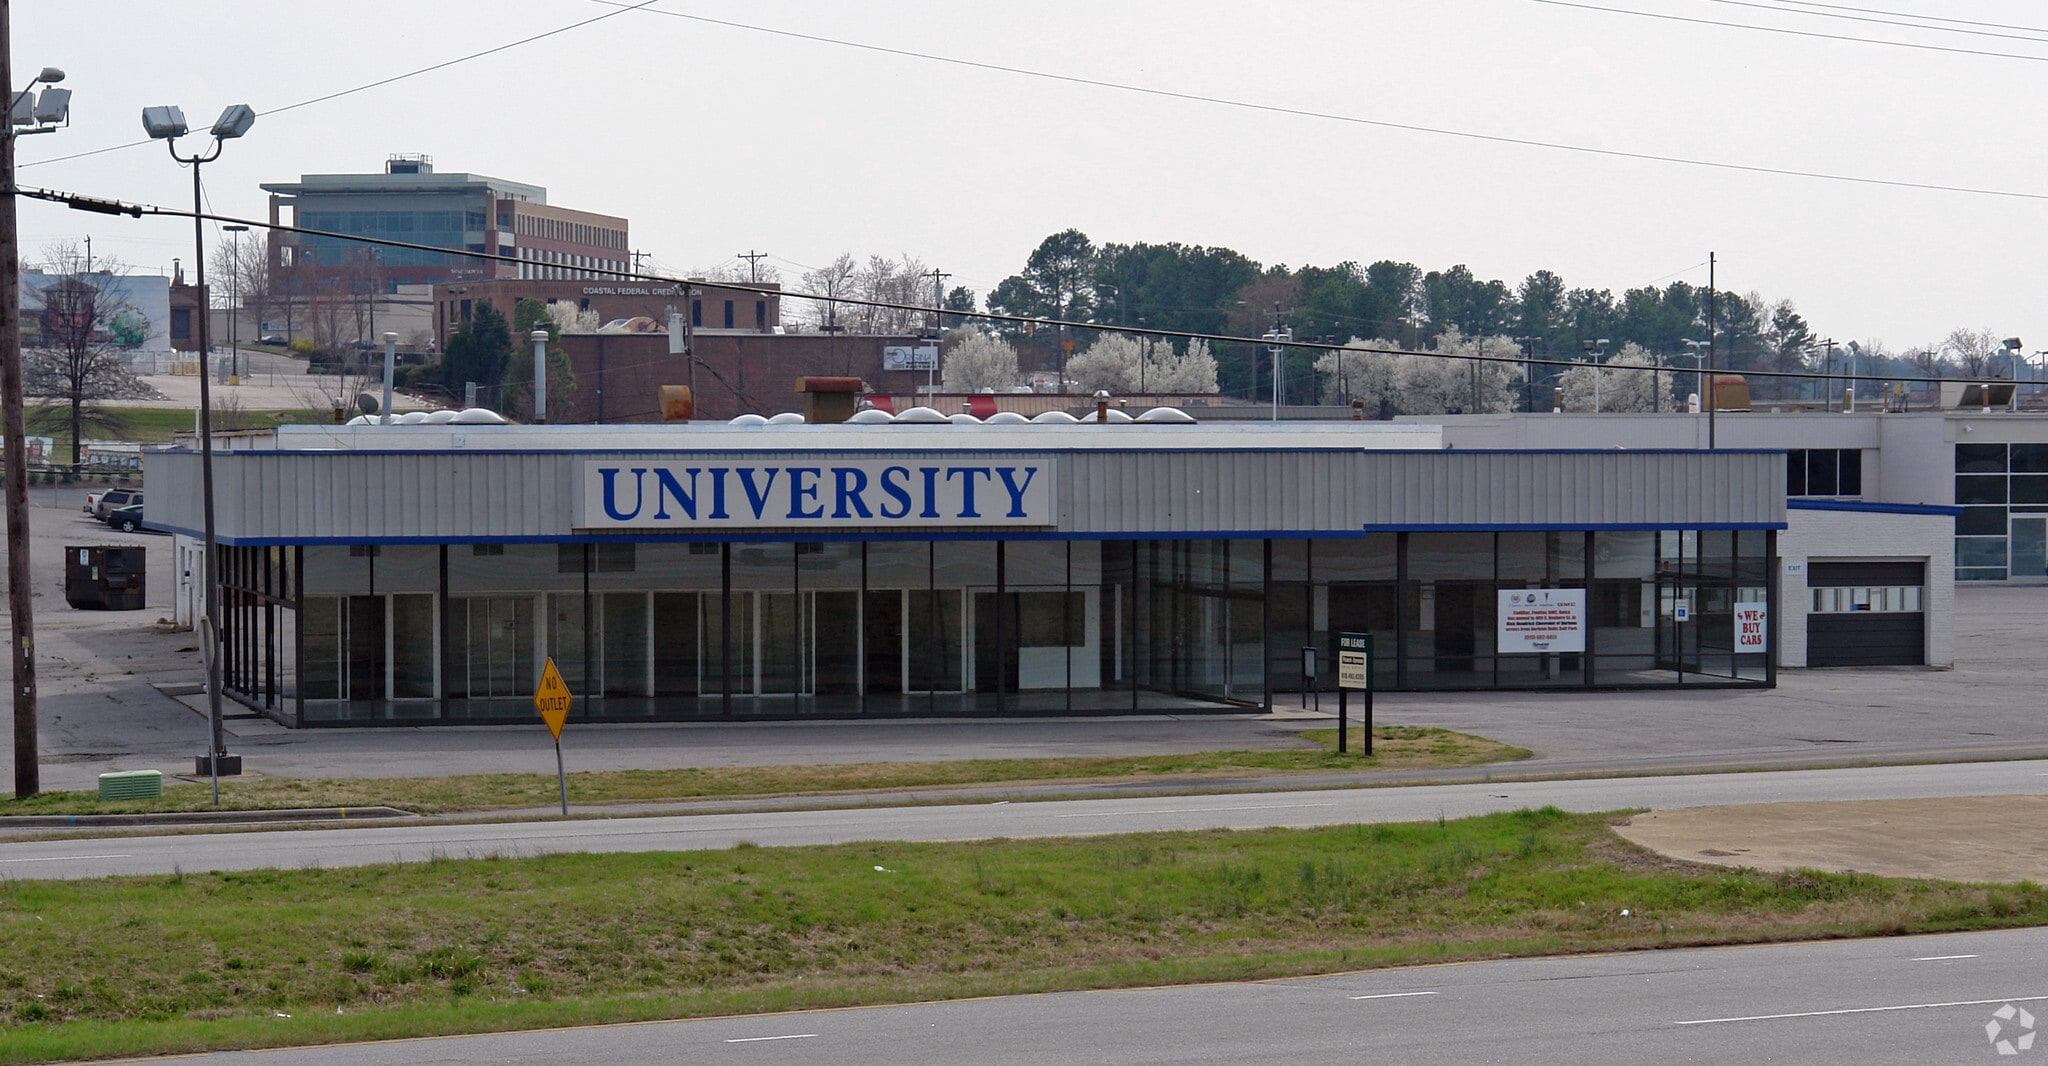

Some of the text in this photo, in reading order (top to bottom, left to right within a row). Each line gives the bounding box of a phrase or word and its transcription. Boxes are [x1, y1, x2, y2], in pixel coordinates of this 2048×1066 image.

[582, 287, 616, 295] COASTAL
[679, 288, 702, 296] UON
[598, 466, 1038, 521] UNIVERSITY
[1744, 611, 1758, 621] WE
[1743, 623, 1760, 633] BUY
[1341, 638, 1365, 648] FOR LEASE
[1741, 635, 1762, 645] CARS
[546, 676, 557, 690] NO
[540, 697, 567, 711] OUTLET
